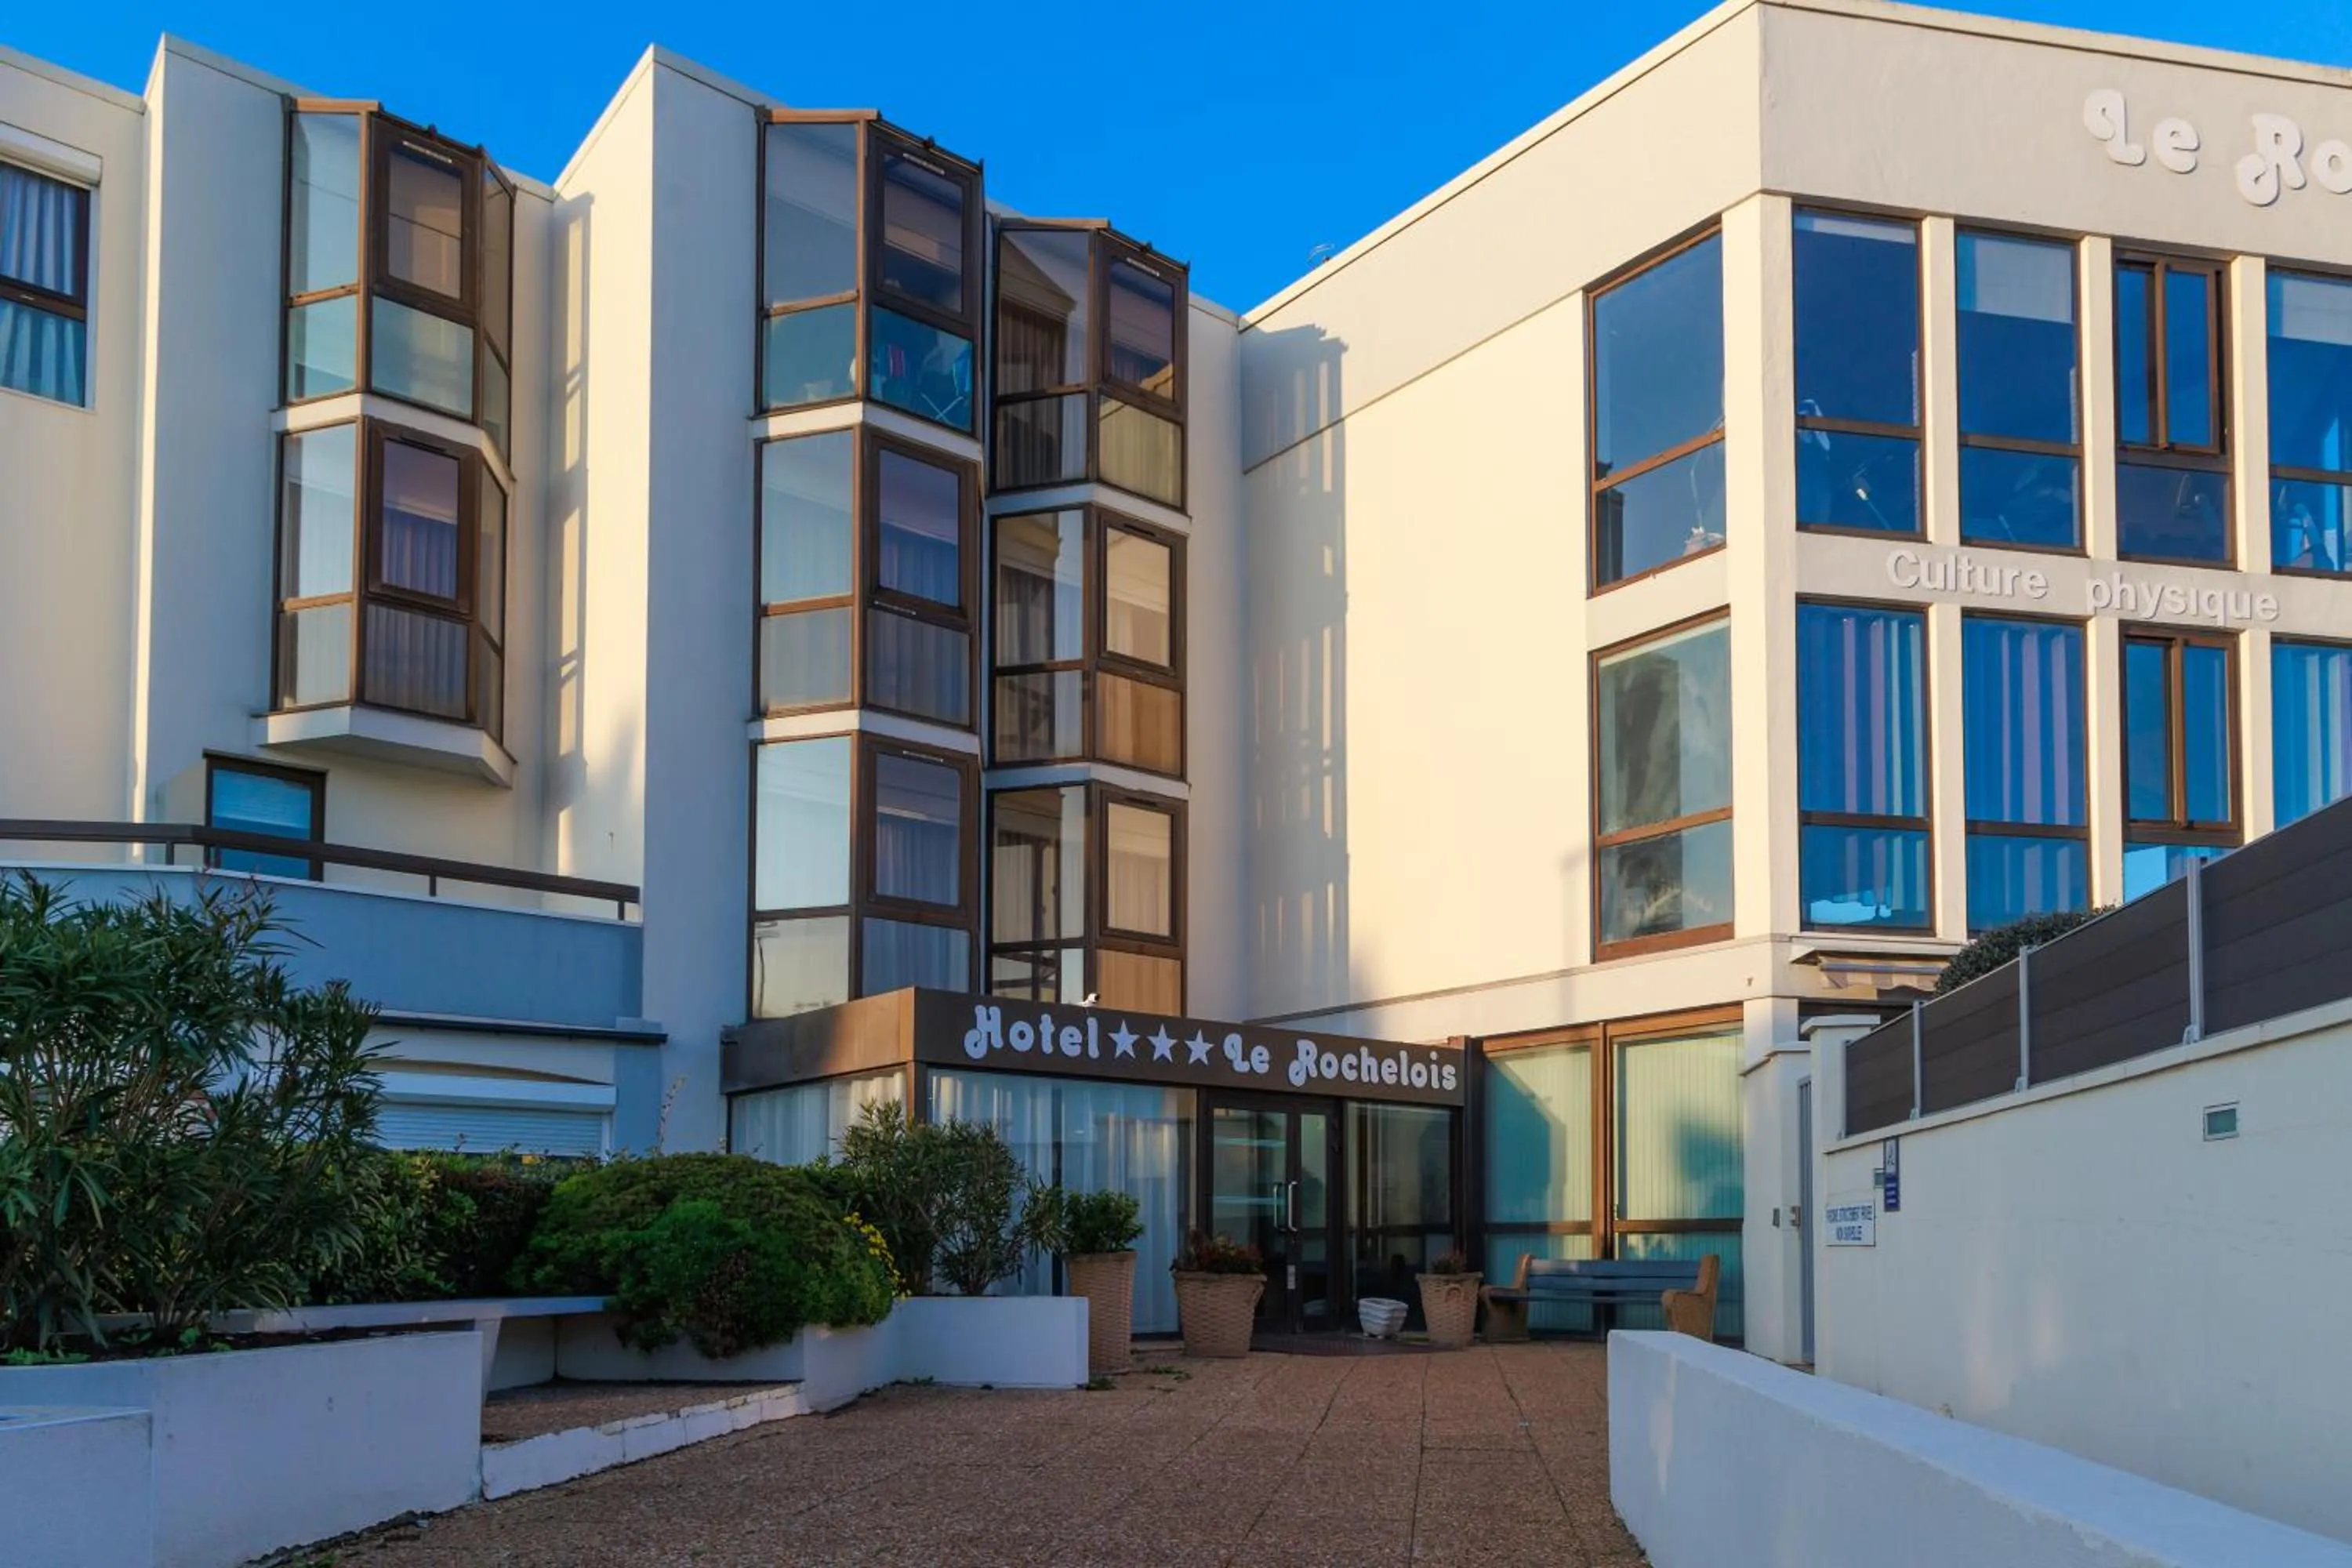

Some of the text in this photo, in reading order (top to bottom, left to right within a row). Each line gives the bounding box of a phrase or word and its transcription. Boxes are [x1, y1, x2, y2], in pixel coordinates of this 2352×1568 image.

[2084, 88, 2201, 174] Le
[1886, 550, 2280, 627] Culture physique
[964, 1004, 1457, 1091] Hotel Le Rochelois
